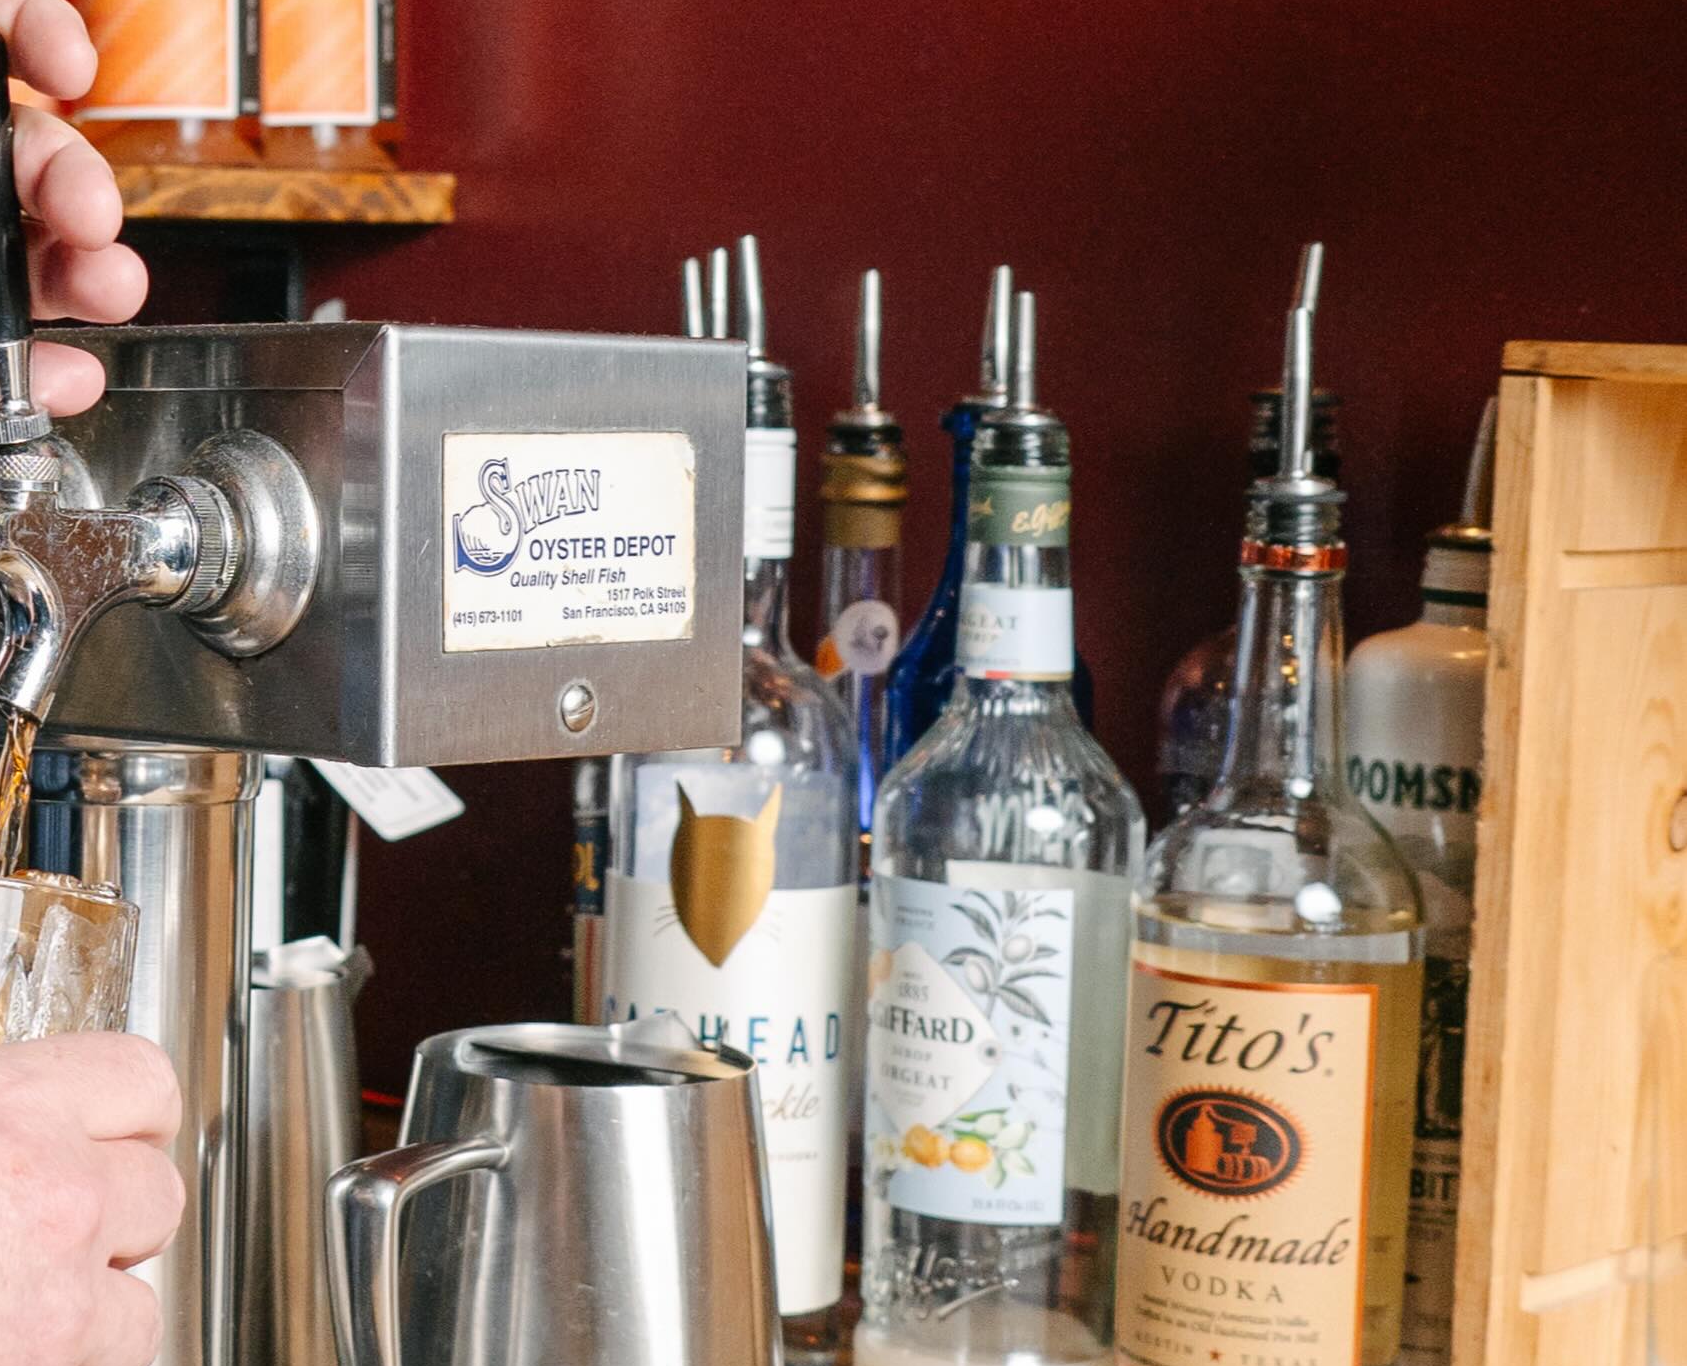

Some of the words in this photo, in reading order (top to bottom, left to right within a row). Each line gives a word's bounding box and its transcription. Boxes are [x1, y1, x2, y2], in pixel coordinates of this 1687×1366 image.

[453, 457, 601, 577] SWAN
[529, 538, 606, 561] OYSTER
[613, 535, 676, 558] DEPOT
[510, 571, 558, 590] Quality
[562, 569, 594, 586] Shell
[598, 568, 626, 584] Fish
[607, 589, 630, 602] 1517
[633, 587, 655, 601] Polk
[657, 586, 686, 599] Street
[452, 611, 477, 626] (415)
[479, 610, 522, 624] 673-1101
[562, 606, 583, 620] San
[585, 604, 638, 620] Francisco,
[640, 602, 655, 616] CA
[657, 601, 686, 615] 94109
[605, 994, 841, 1065] HEAD
[1146, 999, 1334, 1074] Tito's
[1126, 1197, 1351, 1267] Handmade
[1161, 1265, 1284, 1303] VODKA
